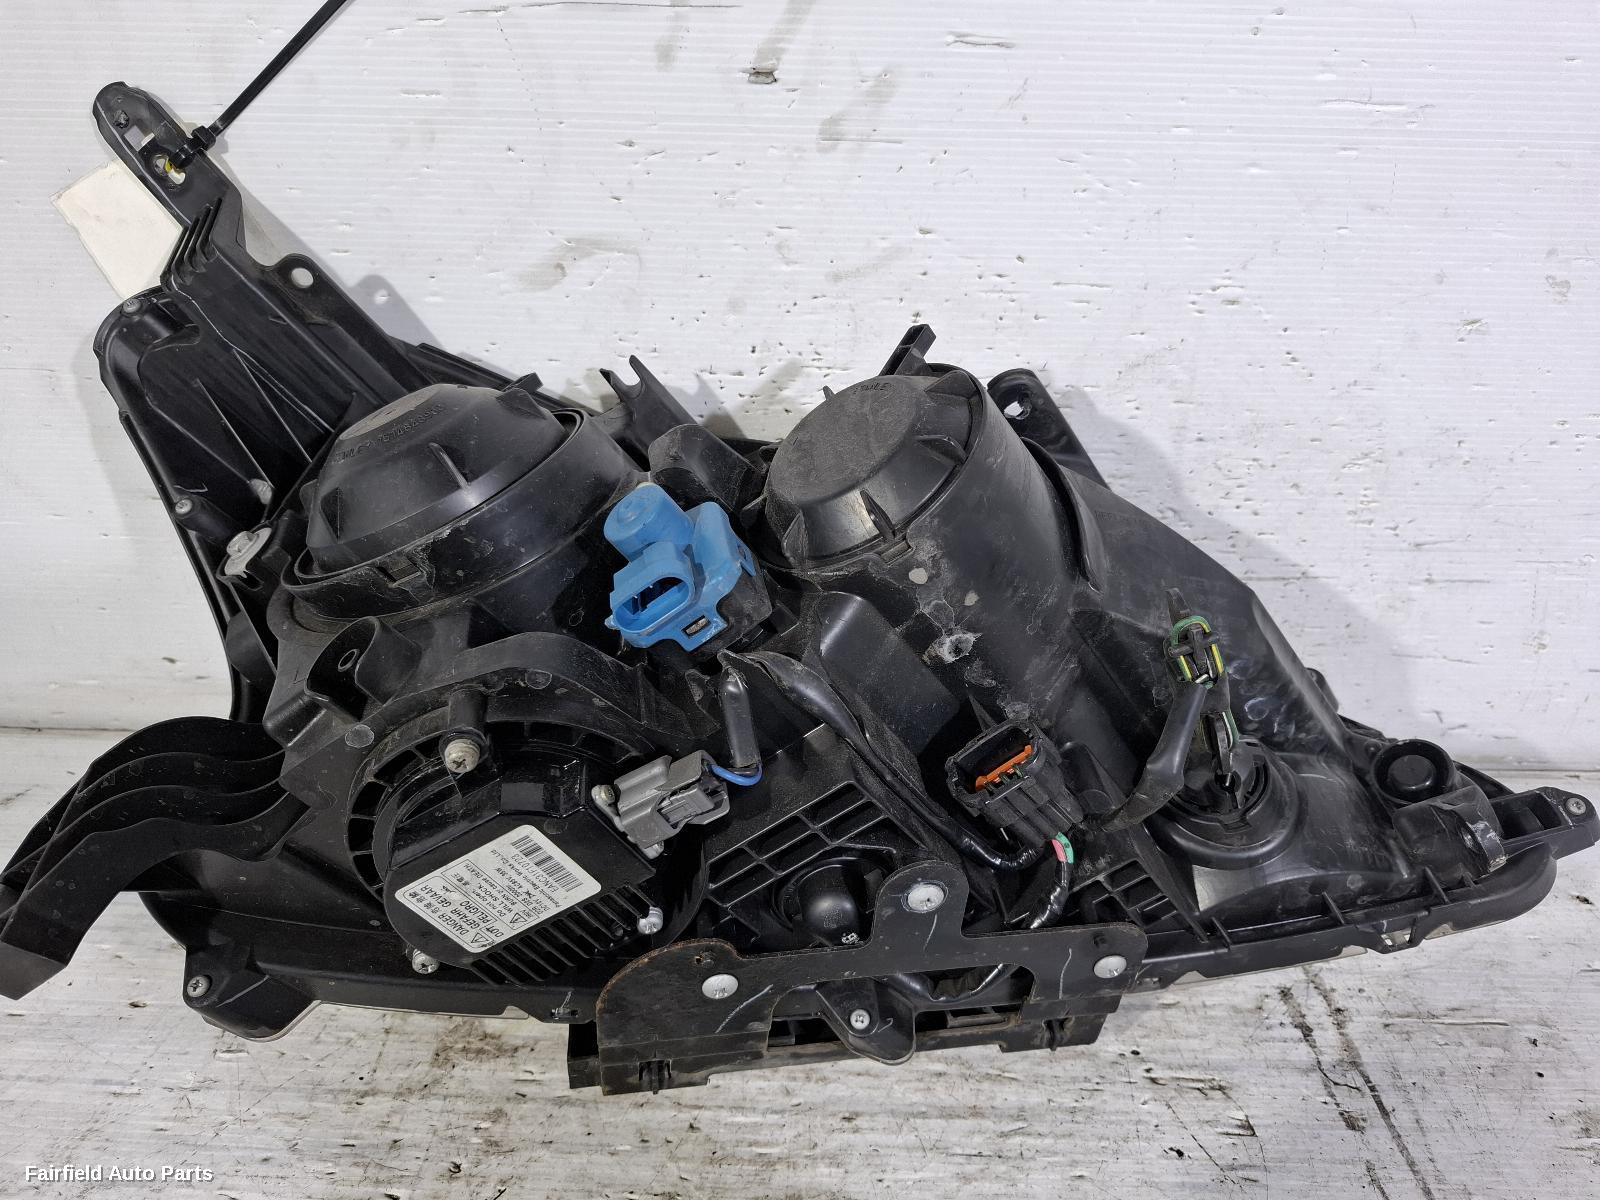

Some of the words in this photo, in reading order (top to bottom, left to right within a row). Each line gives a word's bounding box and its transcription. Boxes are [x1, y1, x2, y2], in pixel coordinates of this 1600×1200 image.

[420, 884, 452, 908] GEVAAR
[501, 893, 517, 905] BURN
[459, 900, 492, 924] PELIGRO
[485, 901, 498, 910] not
[496, 909, 506, 917] Do
[498, 900, 513, 913] WILL
[437, 912, 469, 935] DANGER
[450, 907, 480, 929] GEFAHR
